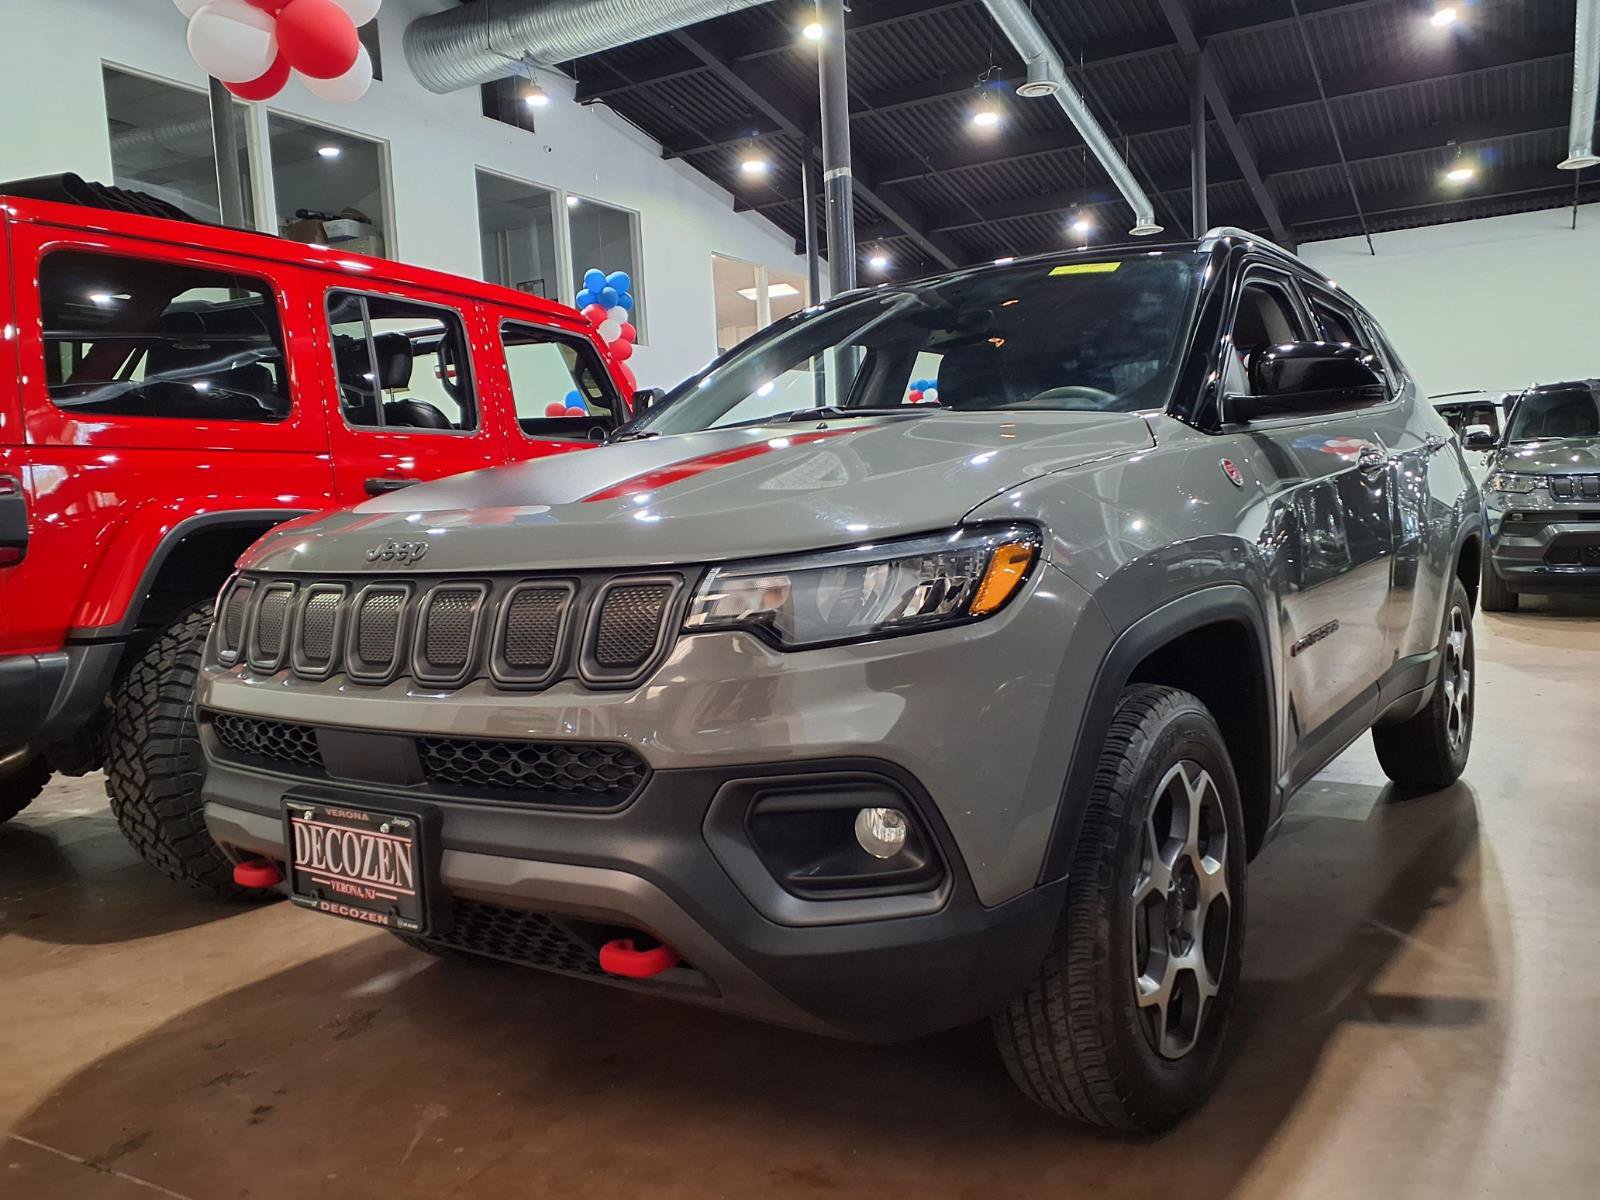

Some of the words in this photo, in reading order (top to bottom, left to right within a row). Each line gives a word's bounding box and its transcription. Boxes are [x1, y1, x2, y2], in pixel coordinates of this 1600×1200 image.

[366, 537, 429, 566] Jeep
[325, 807, 369, 821] VERONA
[292, 822, 413, 889] DECOZEN
[330, 880, 364, 898] VERONA,
[364, 888, 376, 900] NJ
[320, 901, 388, 925] DECOZEN
